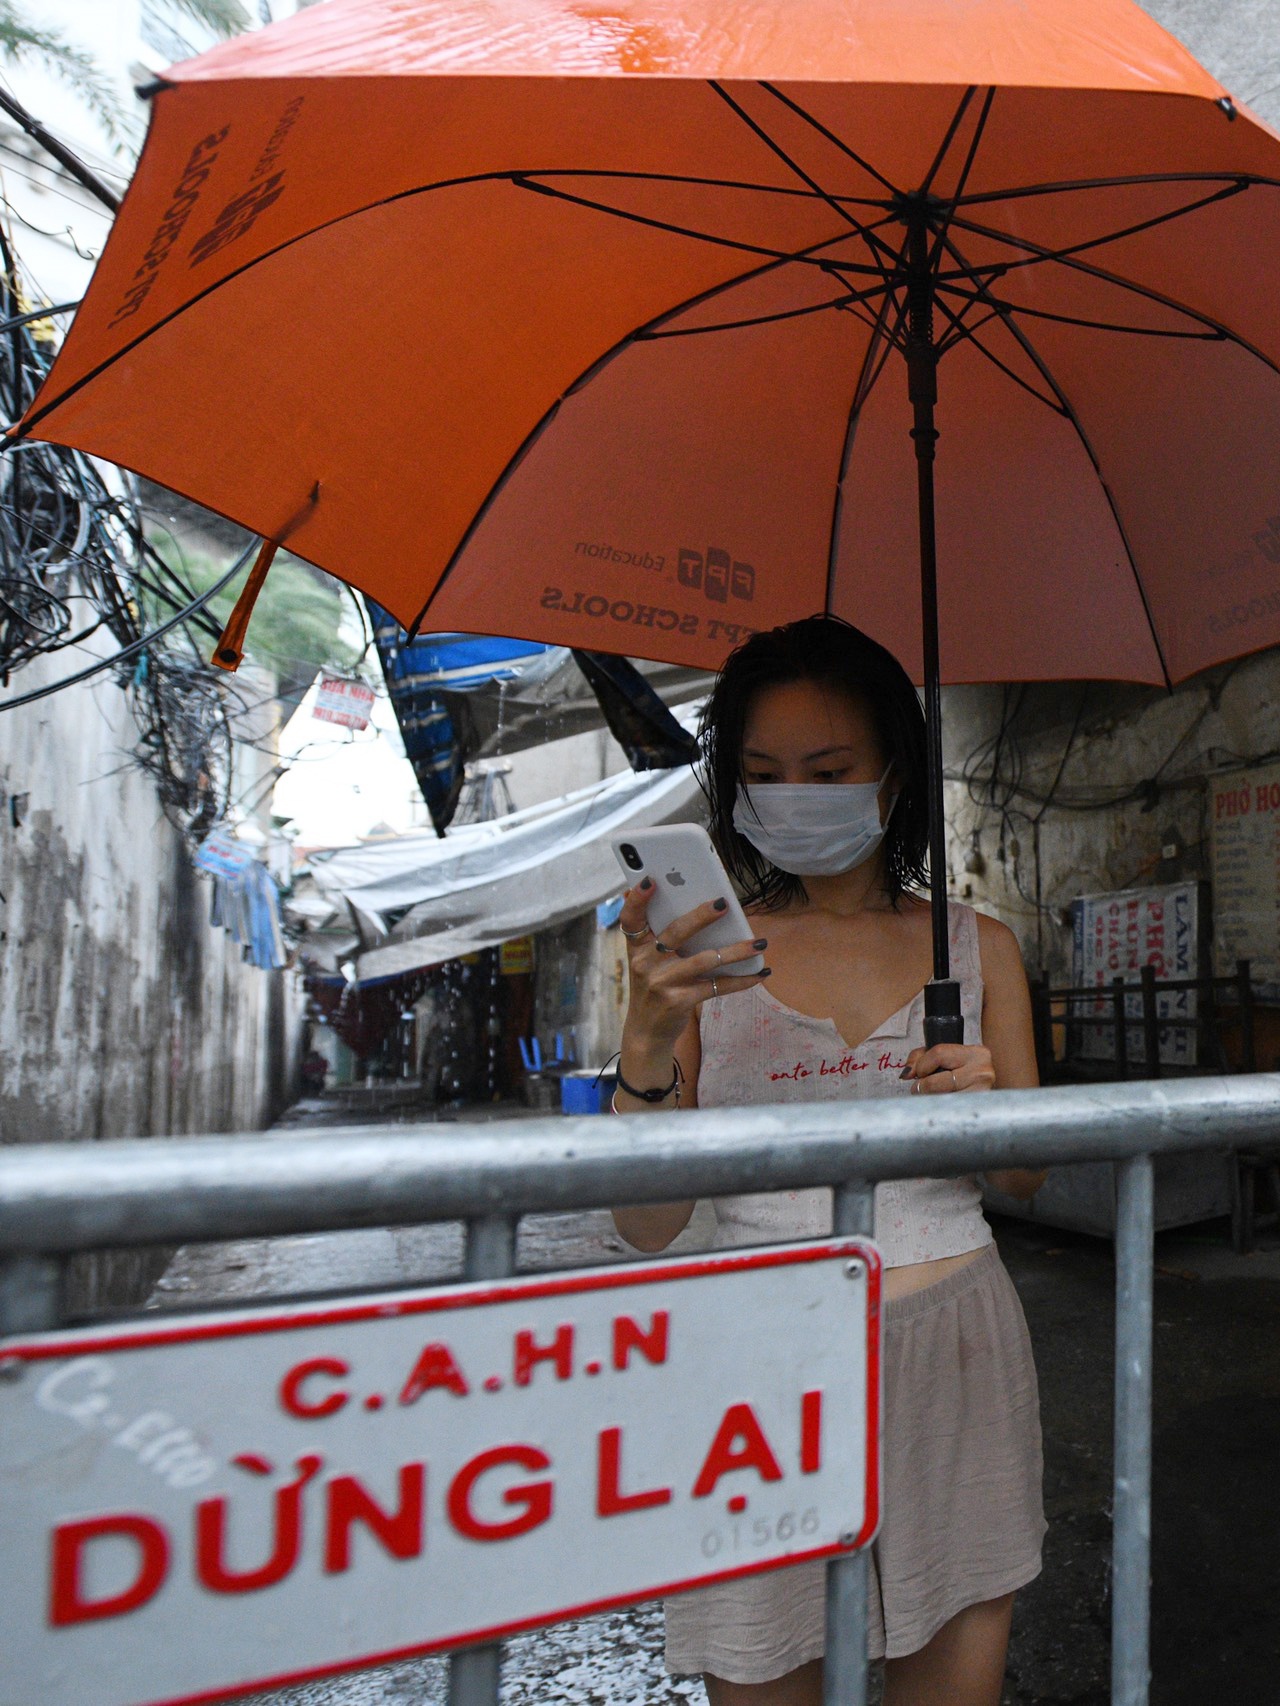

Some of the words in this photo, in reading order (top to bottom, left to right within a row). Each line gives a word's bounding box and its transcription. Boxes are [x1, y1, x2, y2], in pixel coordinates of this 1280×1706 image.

[1146, 898, 1175, 980] PHỞ
[770, 1062, 813, 1081] onto
[820, 1055, 869, 1077] better
[280, 1310, 670, 1420] C.A.H.N
[50, 1445, 555, 1628] DỪNG
[597, 1390, 823, 1519] LẠI
[700, 1507, 821, 1558] 01566
